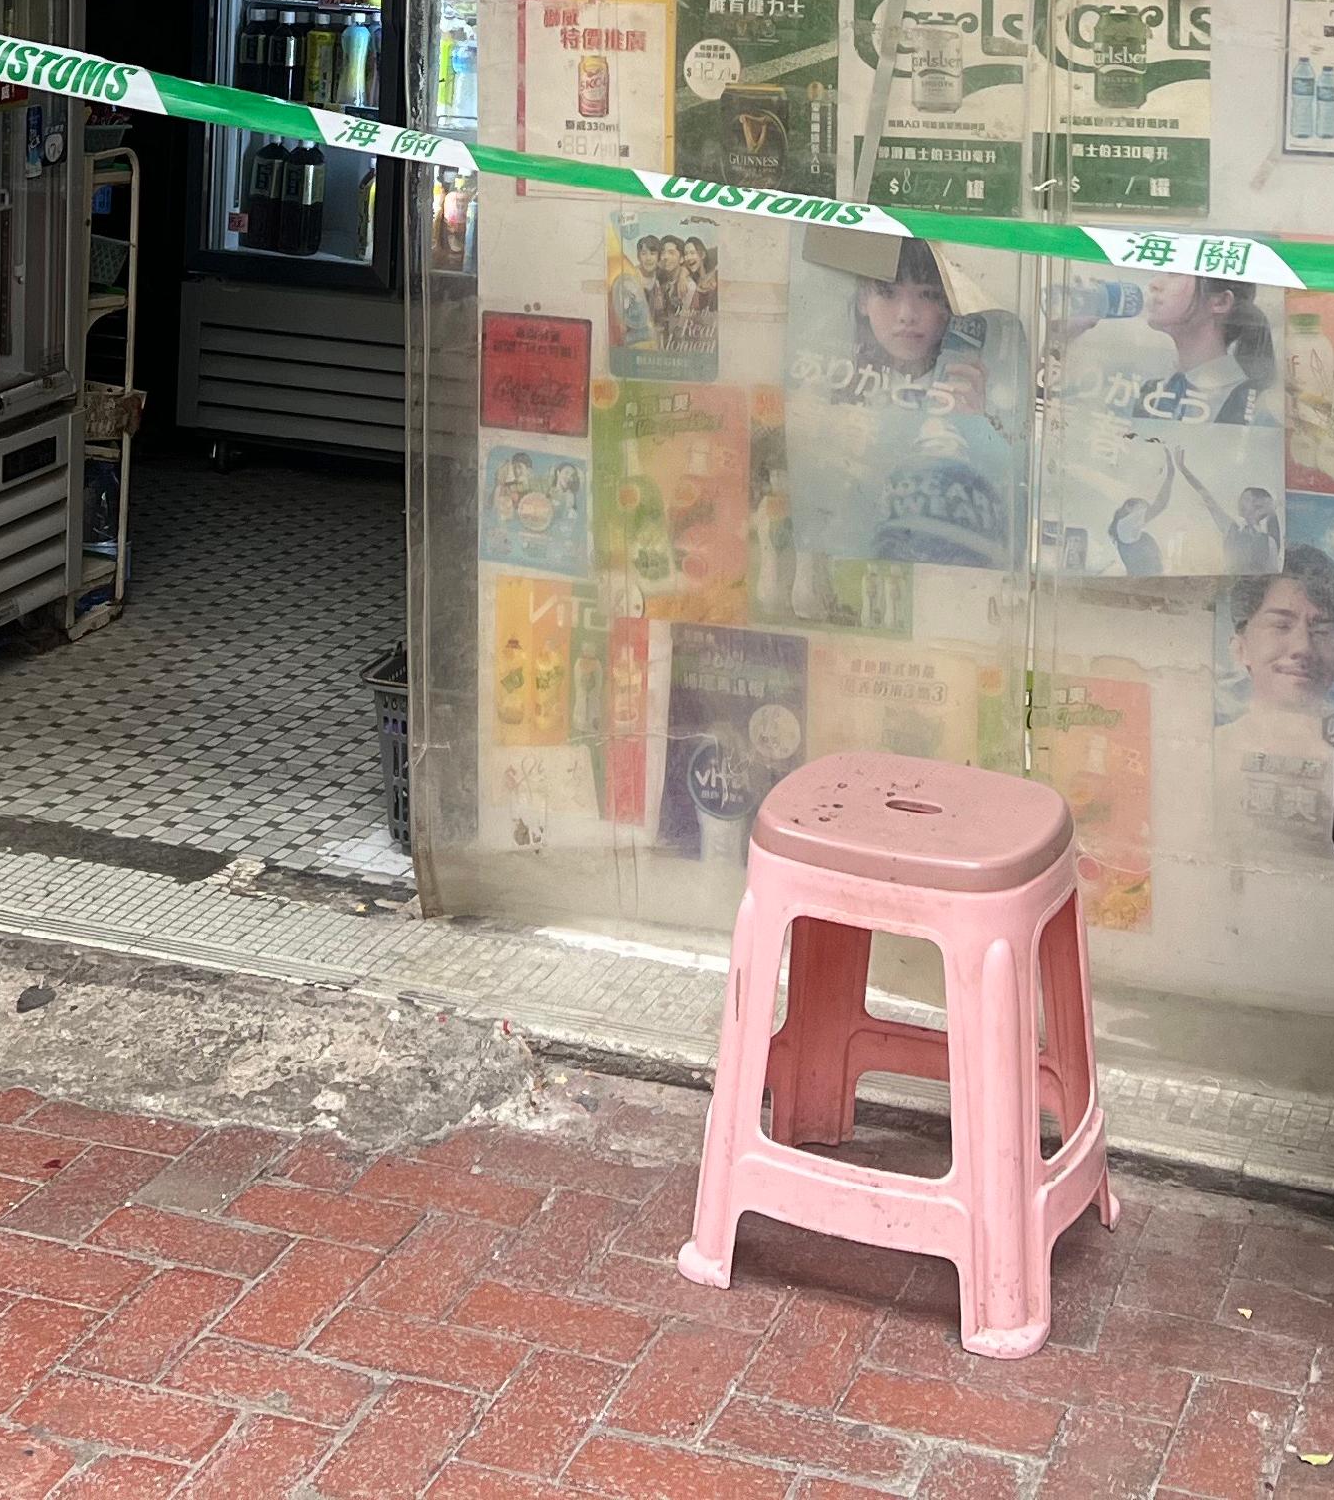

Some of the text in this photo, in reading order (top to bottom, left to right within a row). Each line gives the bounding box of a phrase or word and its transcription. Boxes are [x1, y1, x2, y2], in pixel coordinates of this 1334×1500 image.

[728, 152, 779, 167] GUINNESS
[661, 174, 871, 226] CUSTOMS
[889, 177, 899, 194] $
[1121, 230, 1253, 276] 海關
[790, 348, 957, 416] ありがとう
